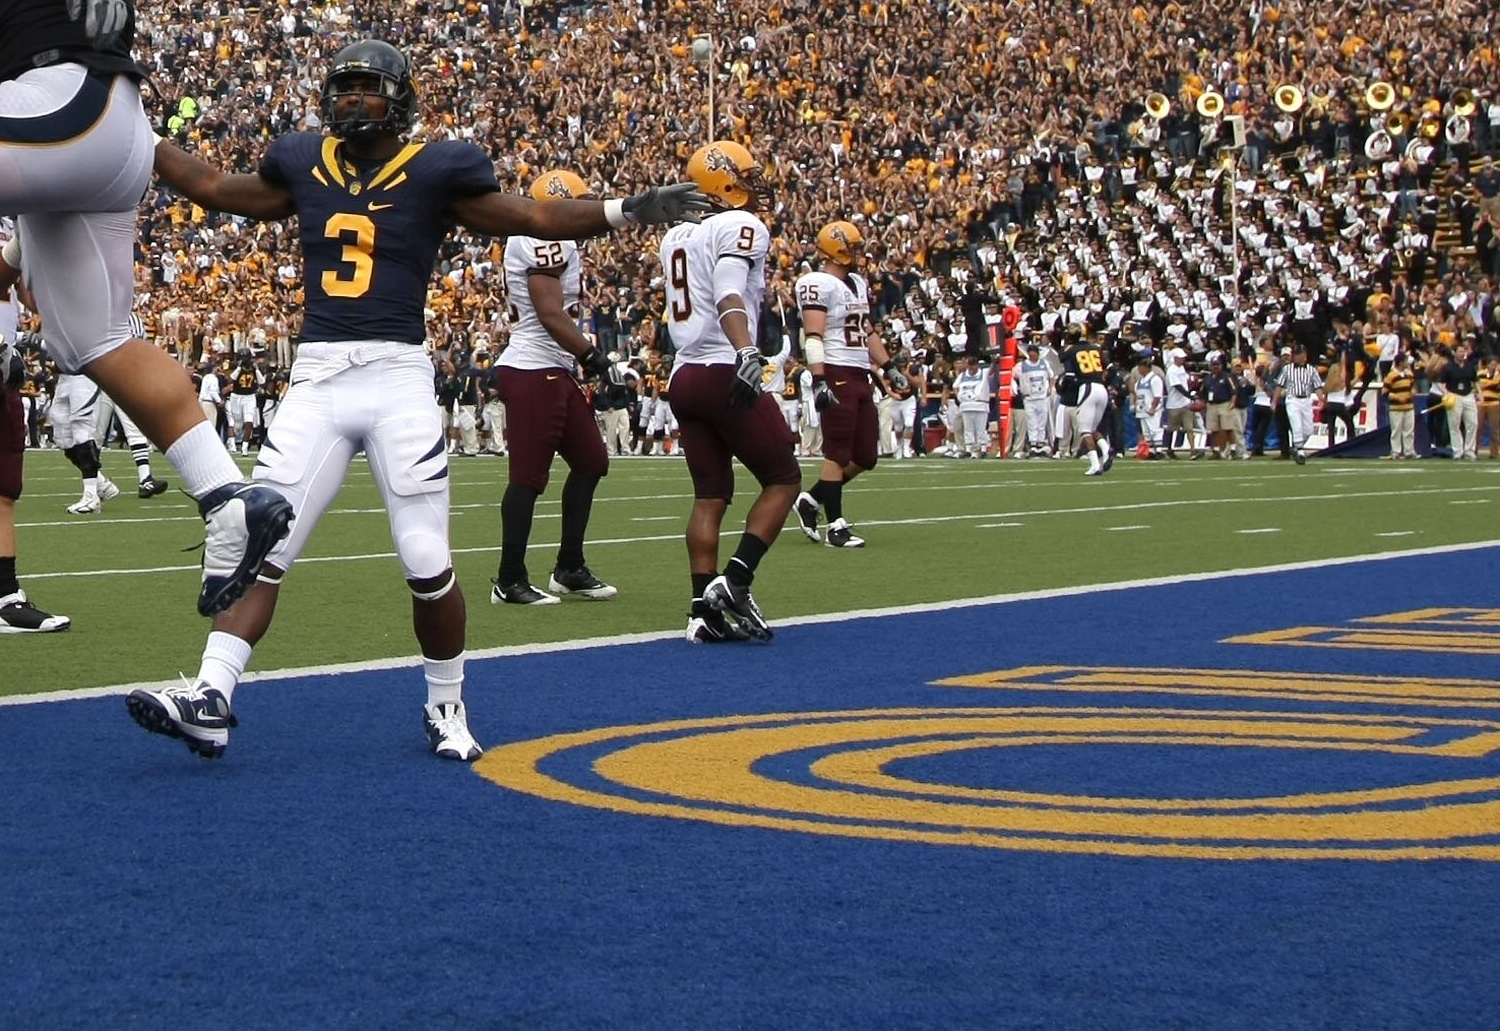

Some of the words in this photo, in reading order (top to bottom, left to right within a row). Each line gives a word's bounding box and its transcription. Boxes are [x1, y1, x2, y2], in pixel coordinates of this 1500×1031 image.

[737, 226, 755, 251] 9
[321, 212, 376, 298] 3
[534, 242, 563, 268] 52
[671, 248, 693, 322] 9
[800, 285, 820, 301] 25
[1076, 348, 1103, 375] 86
